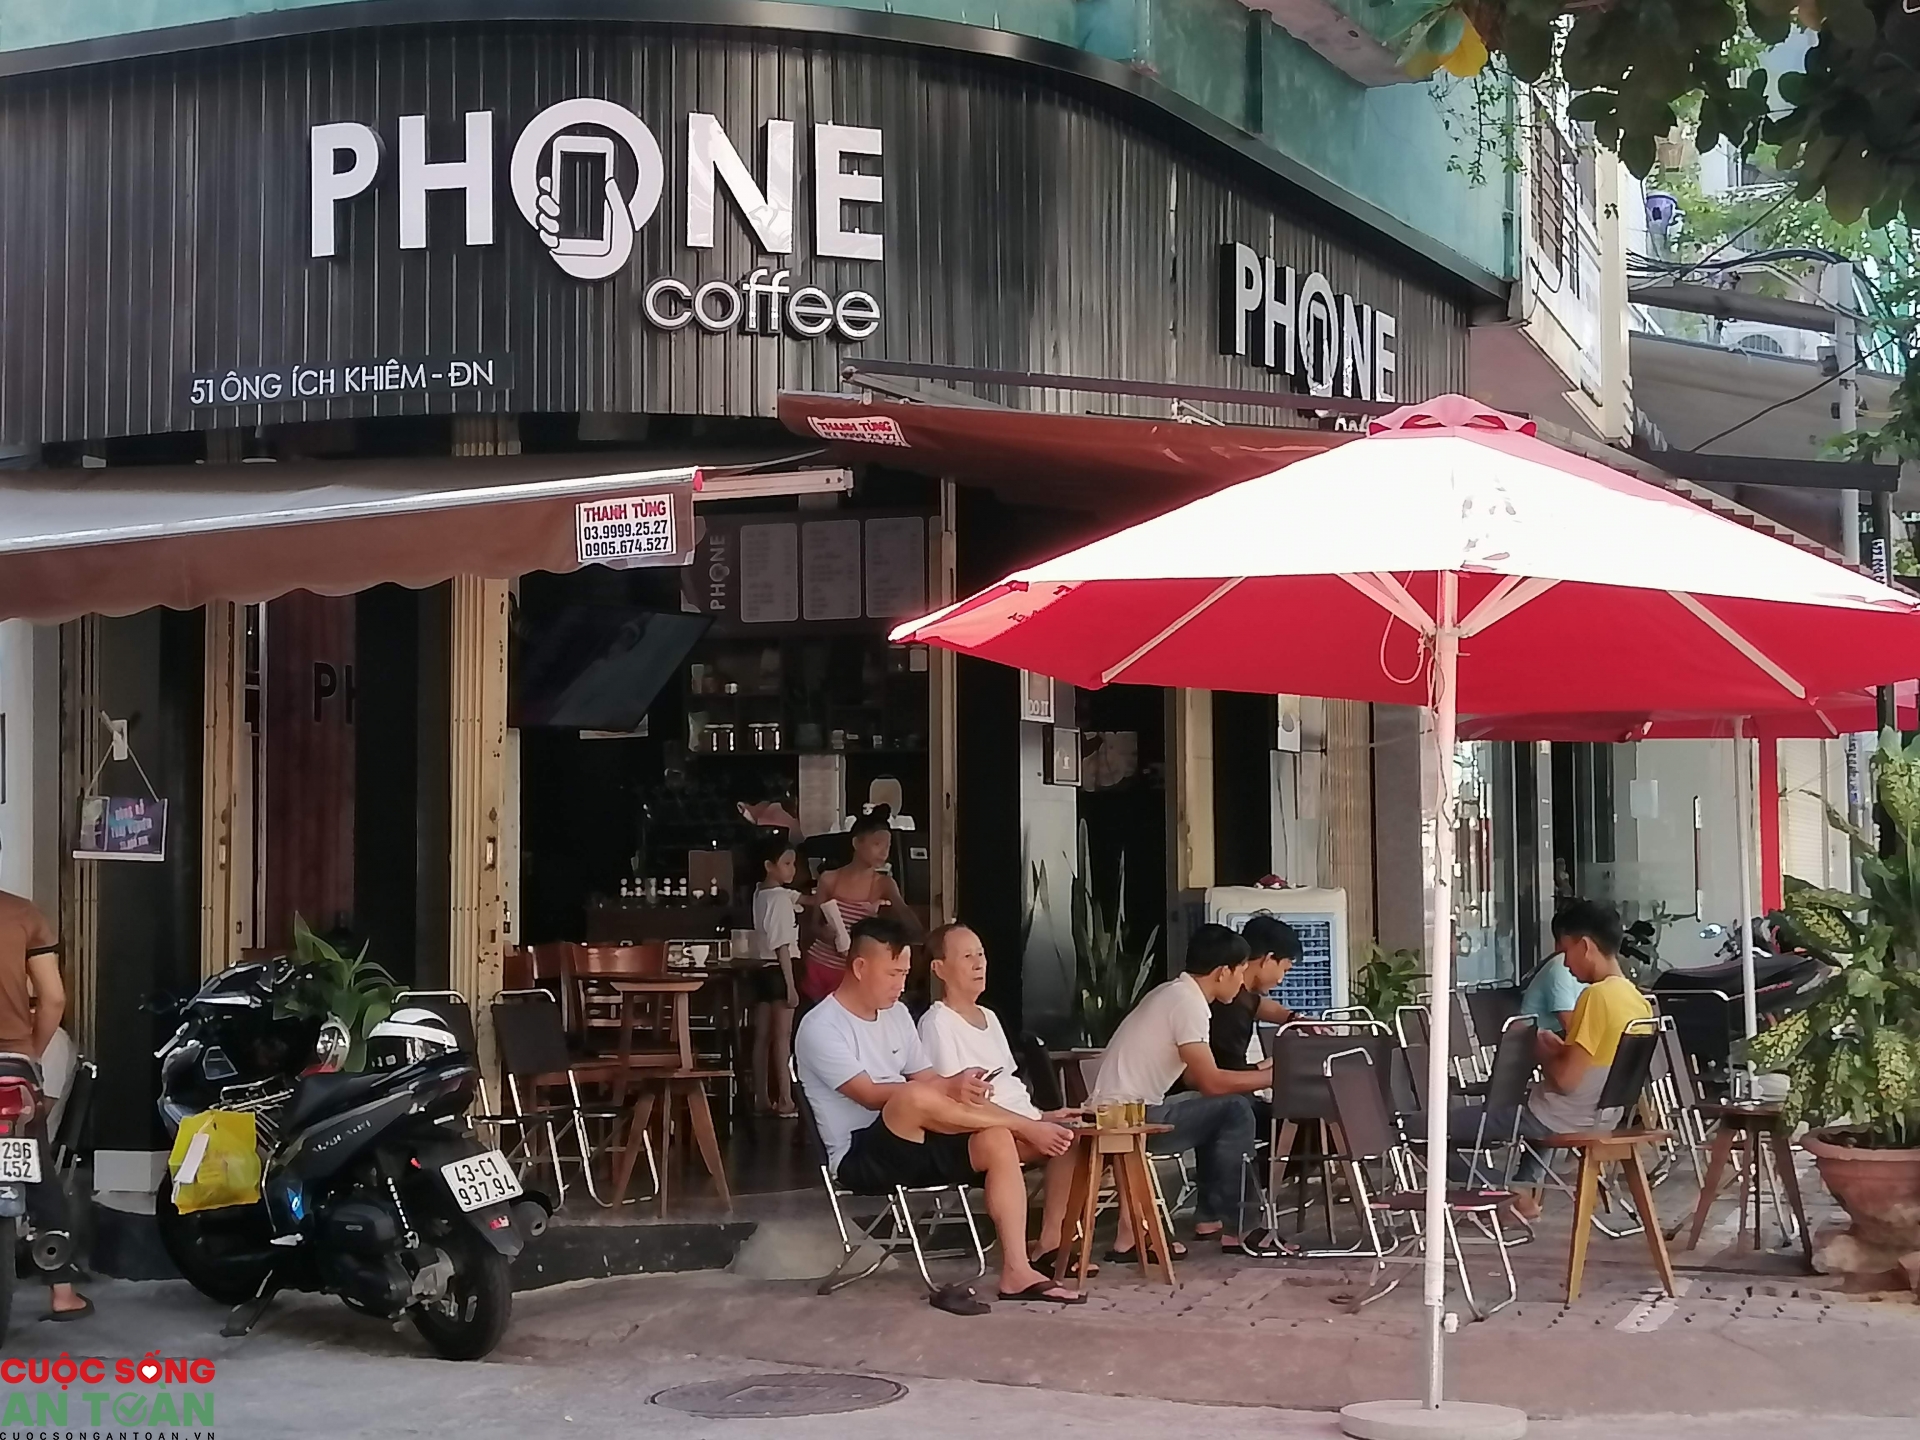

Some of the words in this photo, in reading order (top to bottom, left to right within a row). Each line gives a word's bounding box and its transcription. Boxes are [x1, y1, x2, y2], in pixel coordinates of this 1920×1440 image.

[311, 97, 884, 280] PHONE
[644, 268, 881, 341] coffee
[1236, 241, 1396, 403] PHONE
[190, 379, 214, 404] 51
[221, 371, 282, 401] ÔNG
[292, 365, 335, 397] ÍCH
[345, 358, 427, 392] KHIÊM
[448, 360, 494, 387] ĐN
[584, 504, 627, 522] THANH
[631, 499, 667, 518] TÙNG
[584, 520, 668, 540] 03.9999.25.27
[585, 536, 669, 556] 0905.674.527
[709, 535, 730, 610] PHONE
[458, 1174, 516, 1205] 937.94
